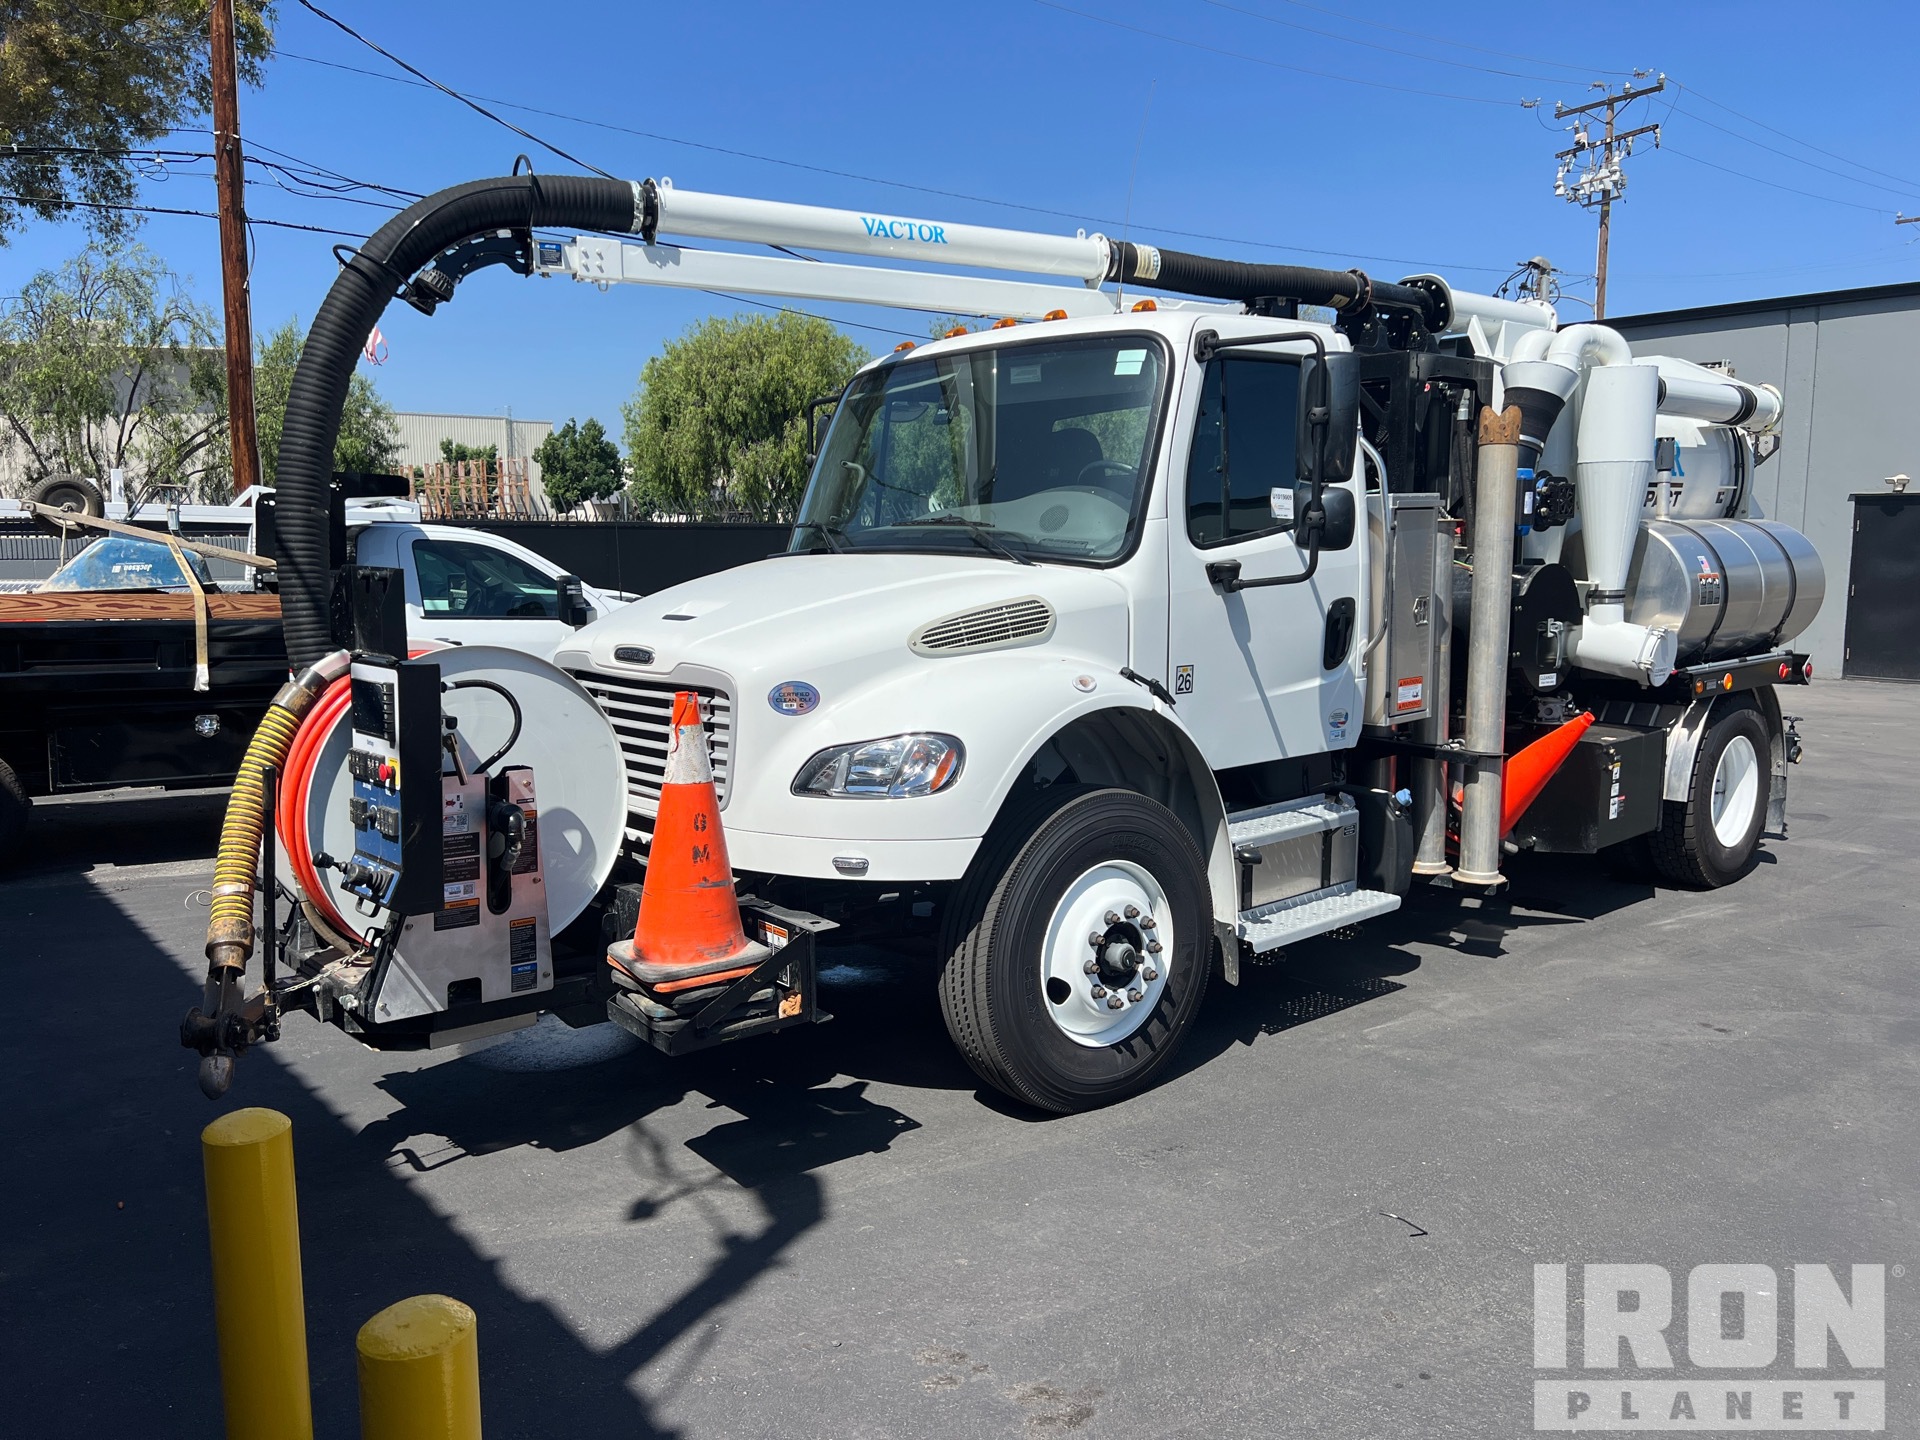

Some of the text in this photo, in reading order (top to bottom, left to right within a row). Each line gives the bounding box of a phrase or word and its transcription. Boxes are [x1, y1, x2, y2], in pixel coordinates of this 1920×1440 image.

[860, 217, 948, 244] VACTOR
[1177, 673, 1192, 692] 26
[1403, 677, 1422, 685] WARNING
[1402, 700, 1421, 708] WARNING
